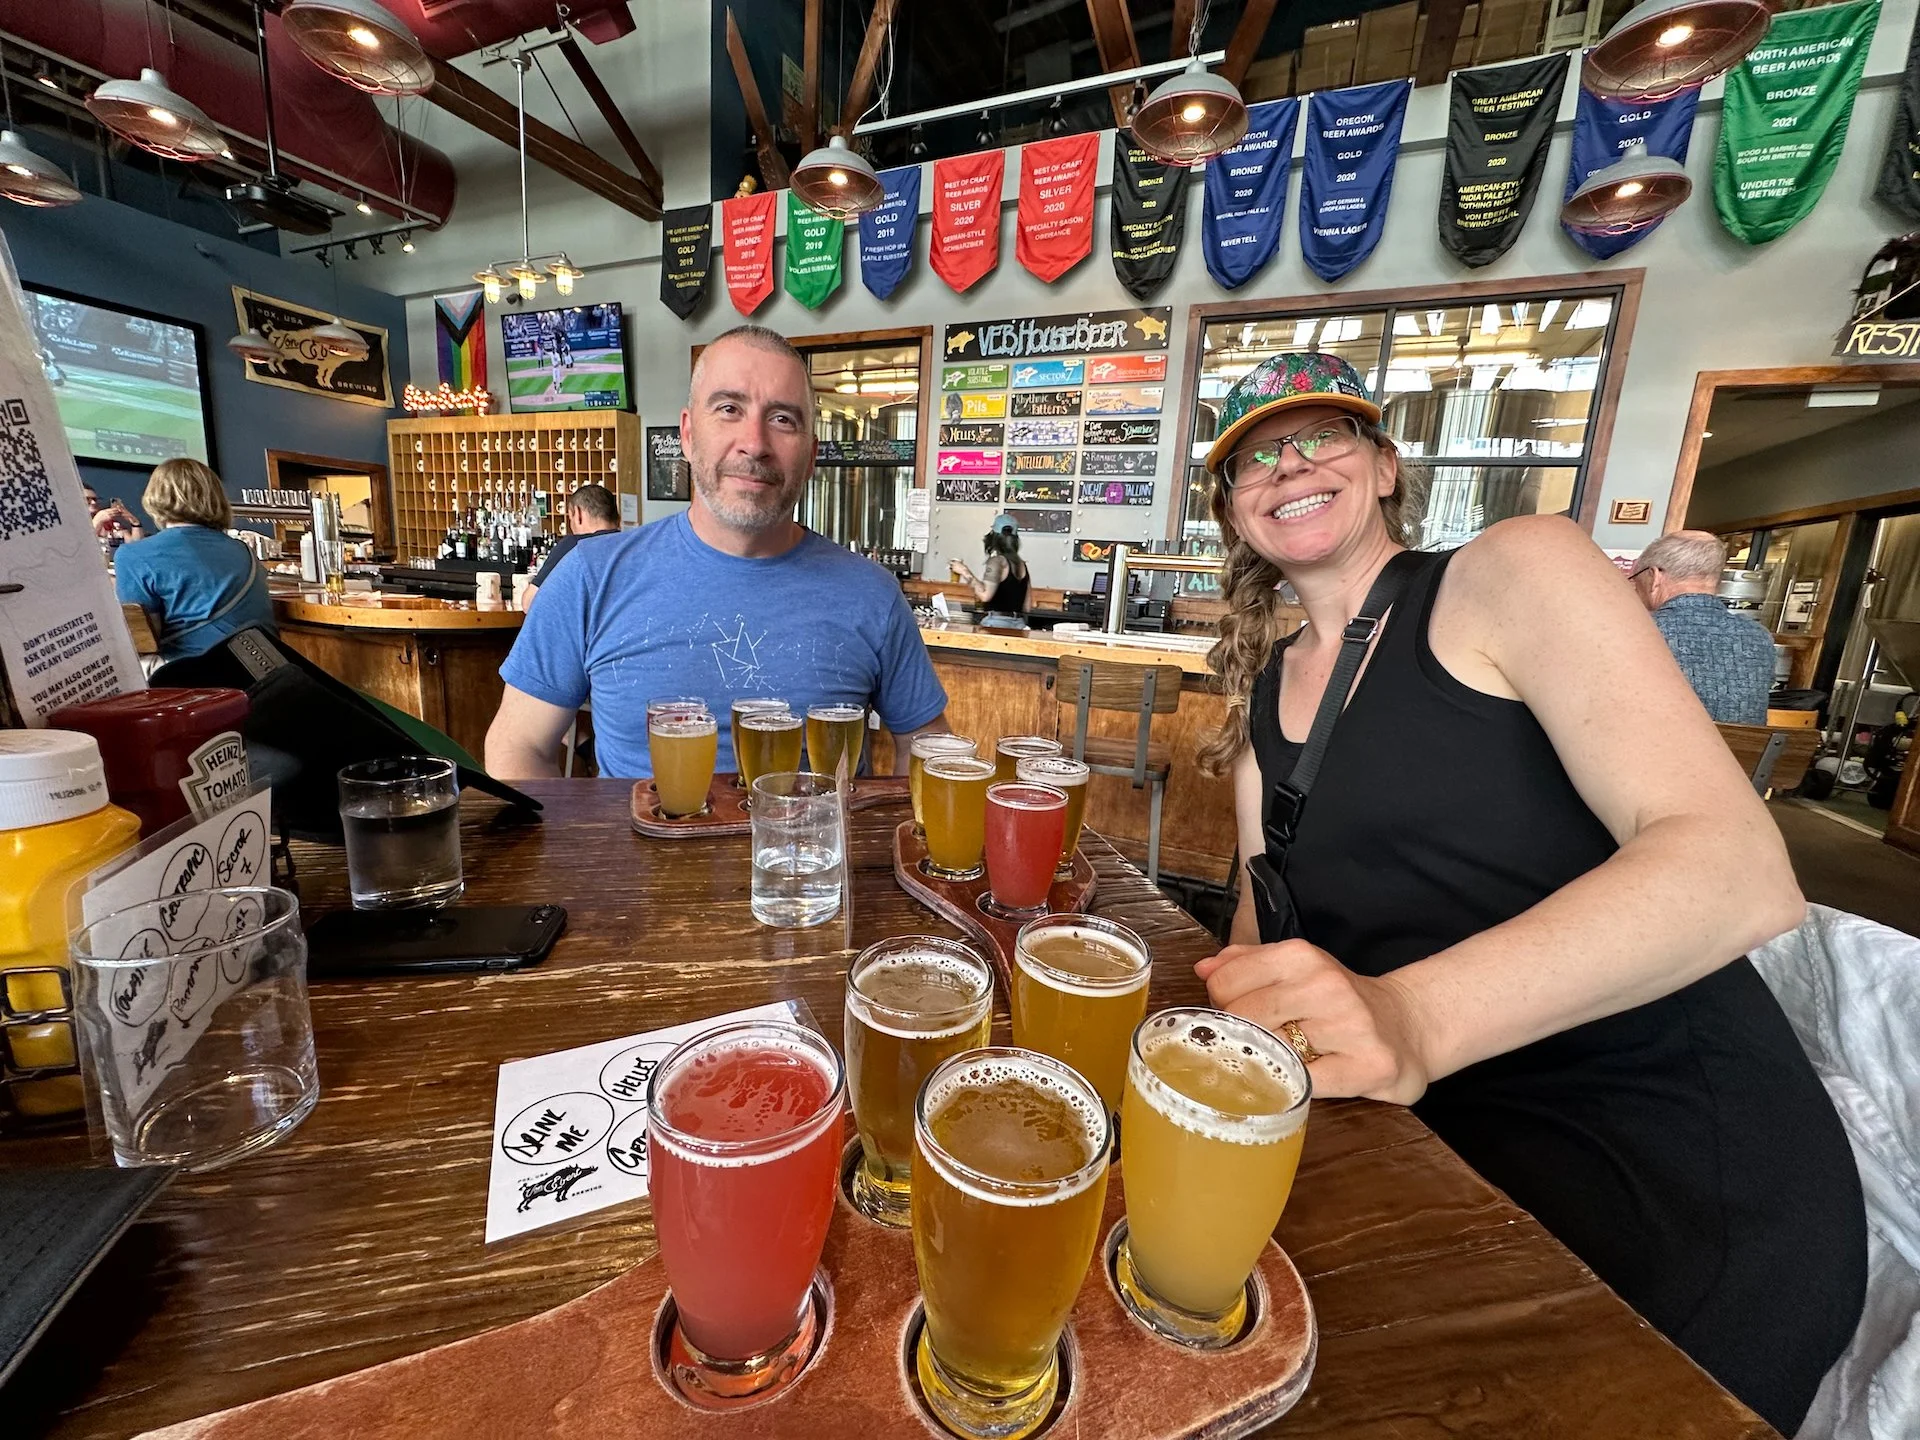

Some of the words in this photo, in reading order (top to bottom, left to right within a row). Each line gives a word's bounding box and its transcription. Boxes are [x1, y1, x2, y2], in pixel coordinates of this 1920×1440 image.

[1745, 48, 1788, 61] NORTH
[1788, 36, 1854, 56] AMERICAN
[1752, 61, 1786, 75] BEER
[1787, 52, 1841, 71] AWARDS
[1472, 96, 1498, 106] GREAT
[1498, 88, 1543, 105] AMERICAN
[1766, 85, 1817, 100] BRONZE
[1473, 104, 1496, 113] BEER
[1336, 114, 1375, 127] OREGON
[1619, 110, 1652, 124] GOLD
[1771, 116, 1798, 128] 2021
[1323, 129, 1346, 139] BEER
[1346, 122, 1385, 138] AWARDS
[1484, 130, 1519, 142] BRONZE
[1243, 140, 1278, 152] AWARDS
[1129, 155, 1147, 163] BEER
[1337, 150, 1362, 160] GOLD
[1736, 156, 1758, 165] SOUR
[1759, 155, 1769, 163] OR
[1769, 152, 1795, 162] BRETT
[1737, 149, 1761, 158] WOOD
[1033, 167, 1051, 176] BEST
[1051, 164, 1060, 173] OF
[1061, 159, 1083, 170] CRAFT
[1487, 158, 1507, 167] 2020
[1034, 175, 1052, 185] BEER
[1052, 170, 1081, 183] AWARDS
[1230, 165, 1264, 177] BRONZE
[1336, 172, 1357, 183] 2020
[944, 180, 960, 190] BEST
[960, 179, 969, 187] OF
[969, 174, 990, 185] CRAFT
[1138, 176, 1164, 187] BRONZE
[1741, 179, 1777, 190] UNDER
[1777, 177, 1795, 187] THE
[945, 188, 962, 199] BEER
[962, 185, 988, 197] AWARDS
[1039, 185, 1072, 200] SILVER
[1234, 189, 1253, 198] 2020
[1460, 192, 1483, 202] INDIA
[1482, 190, 1504, 201] PALE
[1747, 185, 1796, 200] BETWEEN
[883, 199, 907, 210] AWARDS
[950, 200, 981, 212] SILVER
[1043, 201, 1065, 213] 2020
[1142, 201, 1156, 209] 2020
[1319, 203, 1346, 214] EUROPEAN
[1346, 202, 1367, 211] LAGERS
[1322, 199, 1337, 208] LIGHT
[1337, 197, 1360, 206] GERMAN
[1458, 199, 1492, 210] NOTHING
[1247, 208, 1259, 216] PALE
[1259, 206, 1270, 214] ALE
[1465, 211, 1482, 221] VON
[1482, 207, 1509, 219] EBERT
[797, 216, 812, 225] BEER
[875, 213, 898, 225] GOLD
[954, 215, 975, 226] 2020
[1025, 221, 1059, 233] SPECIALTY
[1058, 215, 1083, 227] SAISON
[1457, 209, 1520, 229] BREWING-PEARL
[804, 227, 826, 238] GOLD
[877, 228, 895, 239] 2019
[1122, 222, 1153, 232] SPECIALTY
[1313, 226, 1341, 237] VIENNA
[1341, 222, 1368, 236] LAGER
[735, 235, 762, 247] BRONZE
[943, 228, 986, 244] GERMAN-STYLE
[1221, 237, 1242, 248] NEVER
[1241, 235, 1258, 245] TELL
[677, 245, 696, 255] GOLD
[805, 242, 823, 251] 2019
[865, 244, 884, 253] FRESH
[884, 243, 897, 251] HOP
[897, 242, 906, 250] IPA
[1130, 246, 1143, 254] VON
[741, 250, 755, 259] 2019
[799, 255, 822, 265] AMERICAN
[822, 254, 832, 262] IPA
[679, 258, 694, 267] 2019
[284, 315, 304, 326] USA
[1075, 317, 1128, 350] BEER
[1039, 372, 1066, 381] SECTOR
[1065, 367, 1074, 382] 7
[337, 380, 378, 393] BREWING
[966, 399, 988, 413] Pils
[949, 427, 976, 443] HELLES
[23, 634, 47, 651] DON'T
[84, 611, 94, 624] TO
[23, 653, 40, 666] ASK
[40, 644, 57, 657] OUR
[57, 634, 77, 649] TEAM
[77, 631, 84, 640] IF
[83, 622, 98, 635] YOU
[26, 662, 48, 678] HAVE
[48, 656, 63, 669] ANY
[63, 634, 103, 660] QUESTIONS!
[31, 691, 48, 704] YOU
[48, 682, 65, 697] MAY
[65, 672, 82, 687] ALSO
[82, 662, 101, 677] COME
[100, 654, 111, 667] UP
[35, 705, 47, 716] TO
[47, 697, 63, 710] THE
[63, 687, 78, 700] BAR
[78, 678, 93, 692] AND
[92, 664, 115, 681] ORDER
[81, 690, 96, 703] ONE
[95, 684, 105, 695] OF
[104, 676, 119, 688] OUR
[205, 744, 240, 772] HEINZ
[202, 768, 247, 801] TOMATO
[217, 828, 252, 883] SECTOR
[611, 1056, 659, 1097] HELLES
[503, 1108, 567, 1158] DRINK
[555, 1125, 590, 1153] ME
[544, 1168, 582, 1193] Ebert
